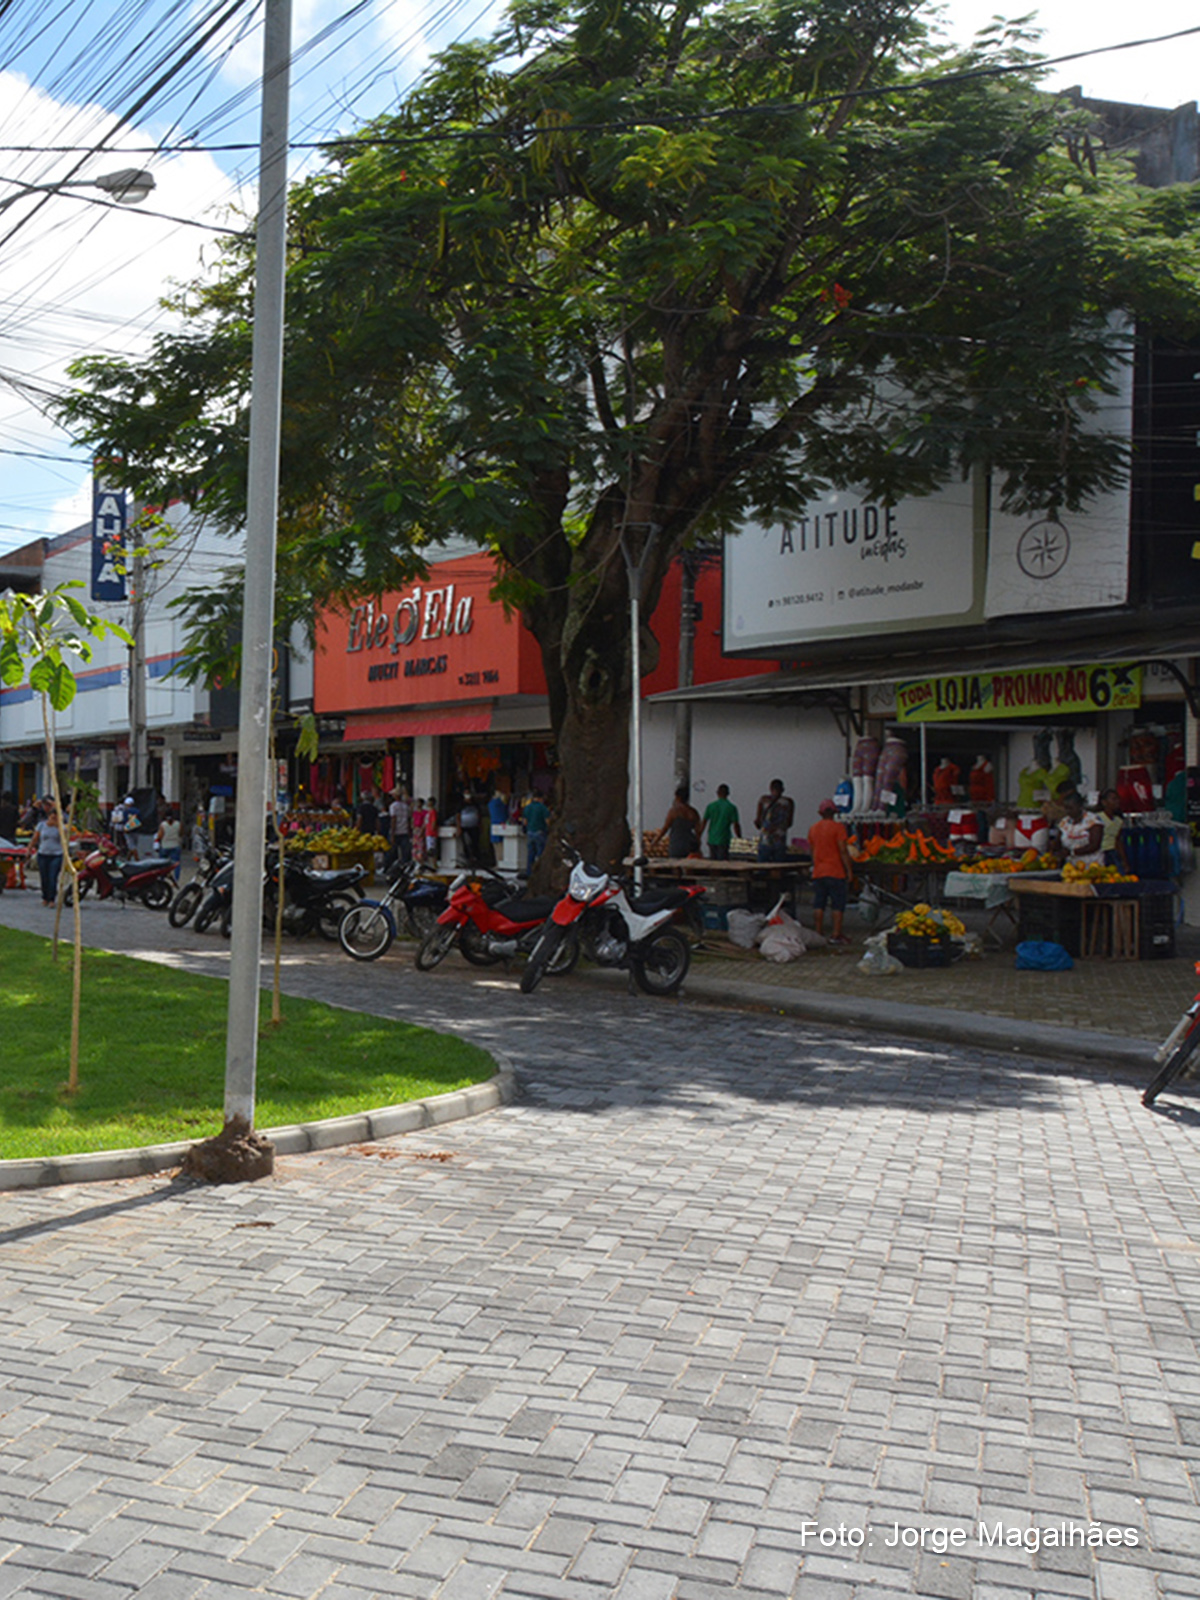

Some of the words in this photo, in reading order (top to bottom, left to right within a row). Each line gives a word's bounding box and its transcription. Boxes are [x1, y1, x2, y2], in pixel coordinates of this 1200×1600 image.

[95, 473, 122, 583] AHA
[780, 501, 898, 555] ATITUDE
[346, 601, 389, 653] Ele
[420, 584, 474, 640] Ela
[404, 655, 448, 678] MARCAS
[900, 683, 933, 708] TODA
[936, 676, 983, 712] LOJA
